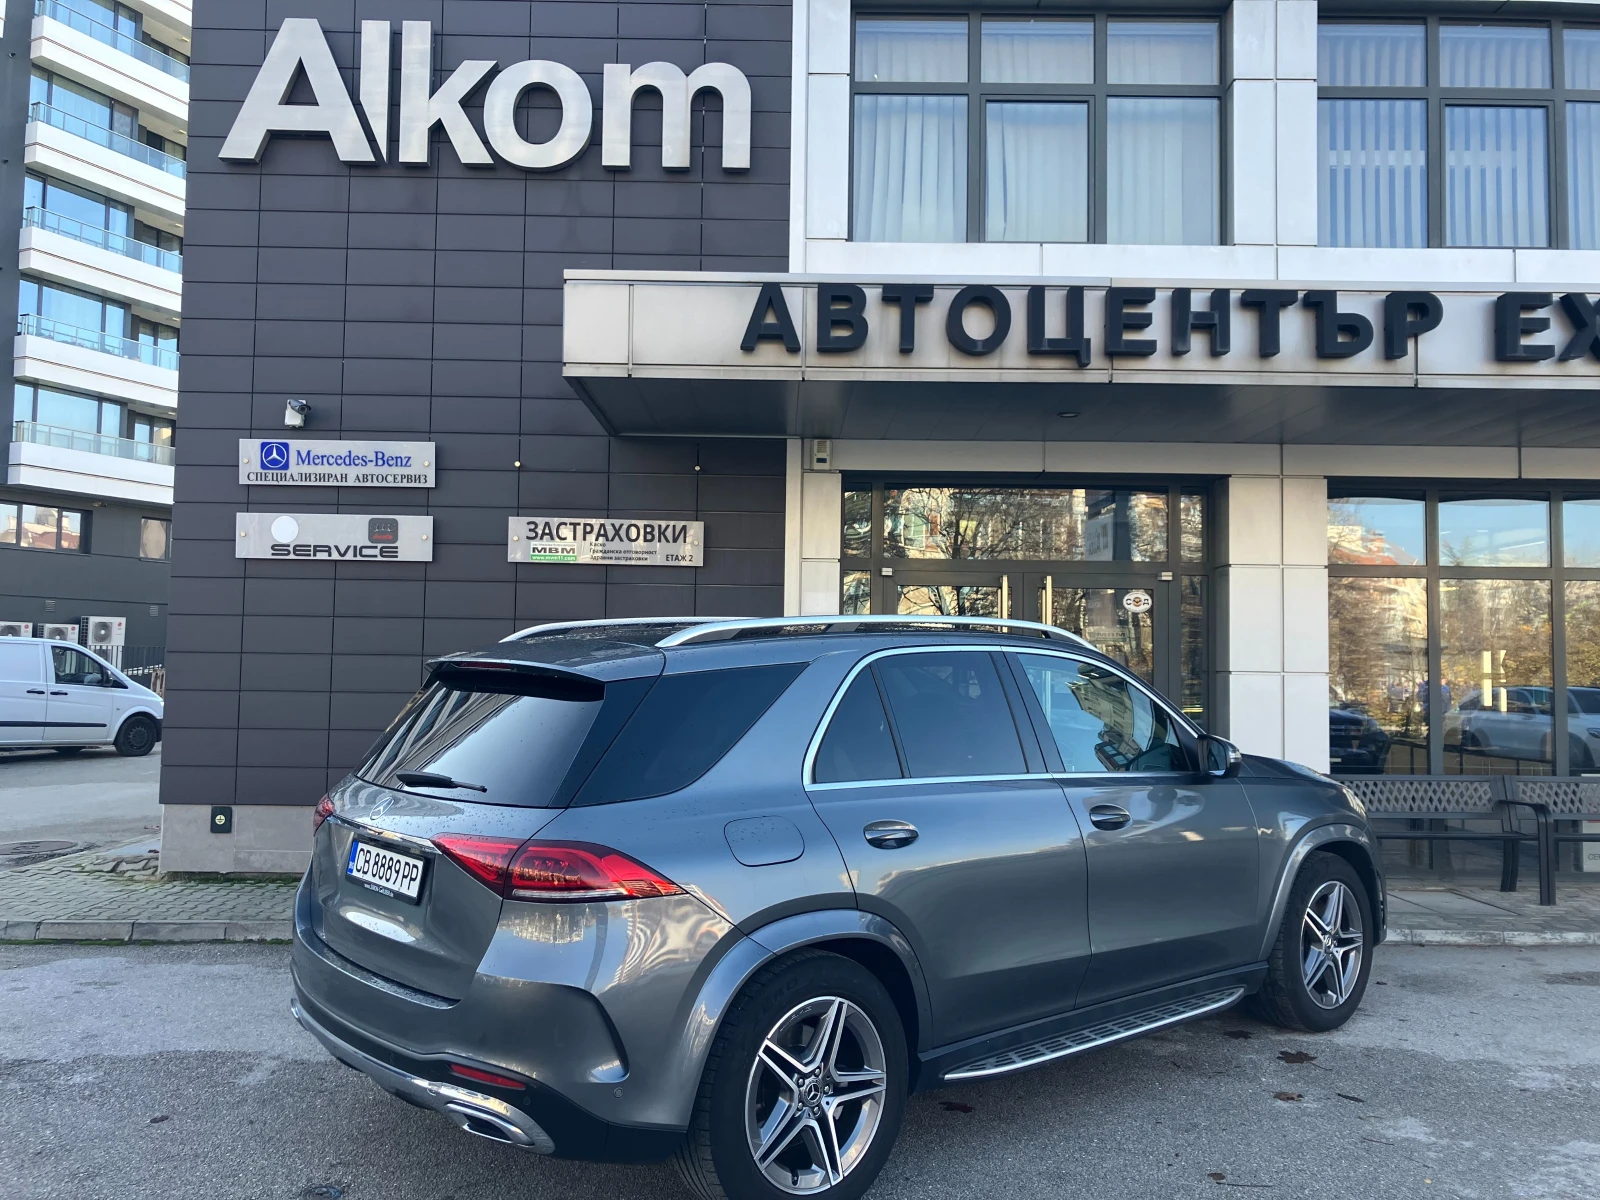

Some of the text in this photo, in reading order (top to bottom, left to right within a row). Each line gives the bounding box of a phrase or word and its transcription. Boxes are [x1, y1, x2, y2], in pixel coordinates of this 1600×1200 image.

[217, 17, 752, 172] Alkom
[740, 282, 1444, 368] АВТОЦЕНТЪР
[295, 449, 412, 468] Mercedes-Benz
[246, 471, 428, 485] СПЕЦИАЛИЗИРАН АВТОСЕРВИЗ
[525, 520, 688, 544] ЗАСТРАХОВКИ
[270, 543, 399, 559] SERVICE
